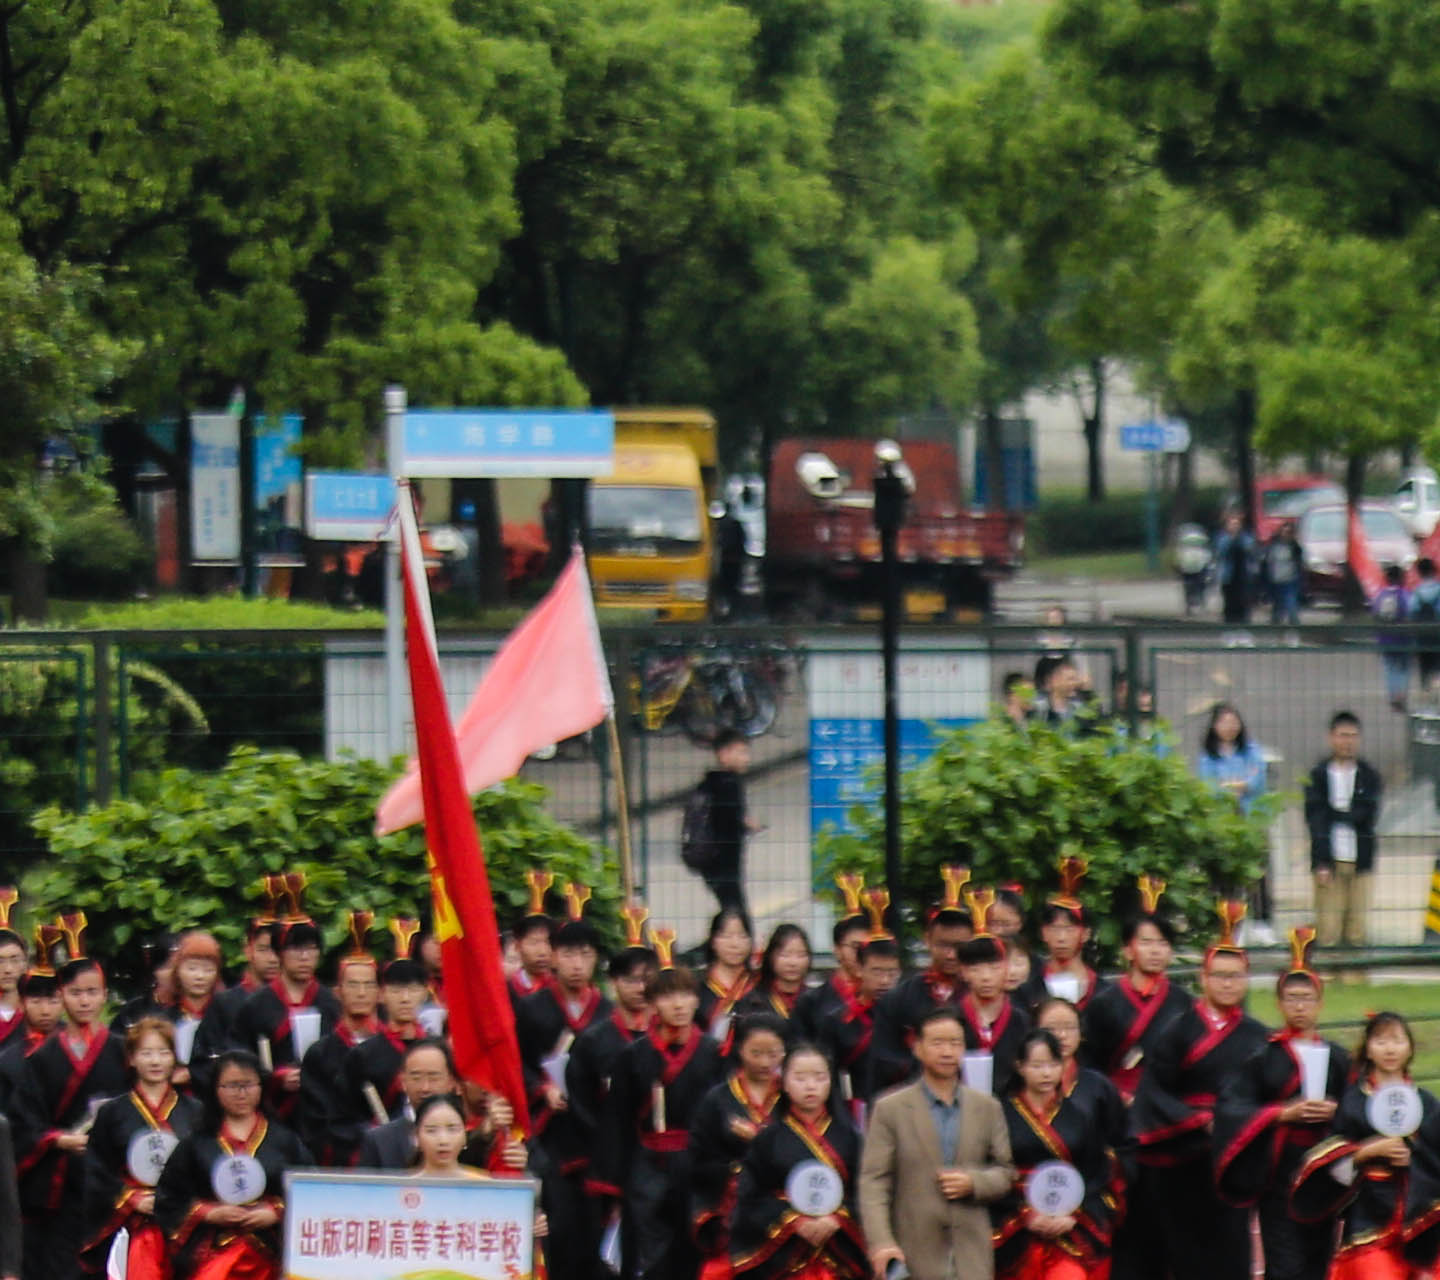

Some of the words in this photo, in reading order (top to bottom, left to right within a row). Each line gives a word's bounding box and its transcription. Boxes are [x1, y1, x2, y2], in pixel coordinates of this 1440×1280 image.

[300, 1217, 522, 1263] 出版印刷高等专科学校
